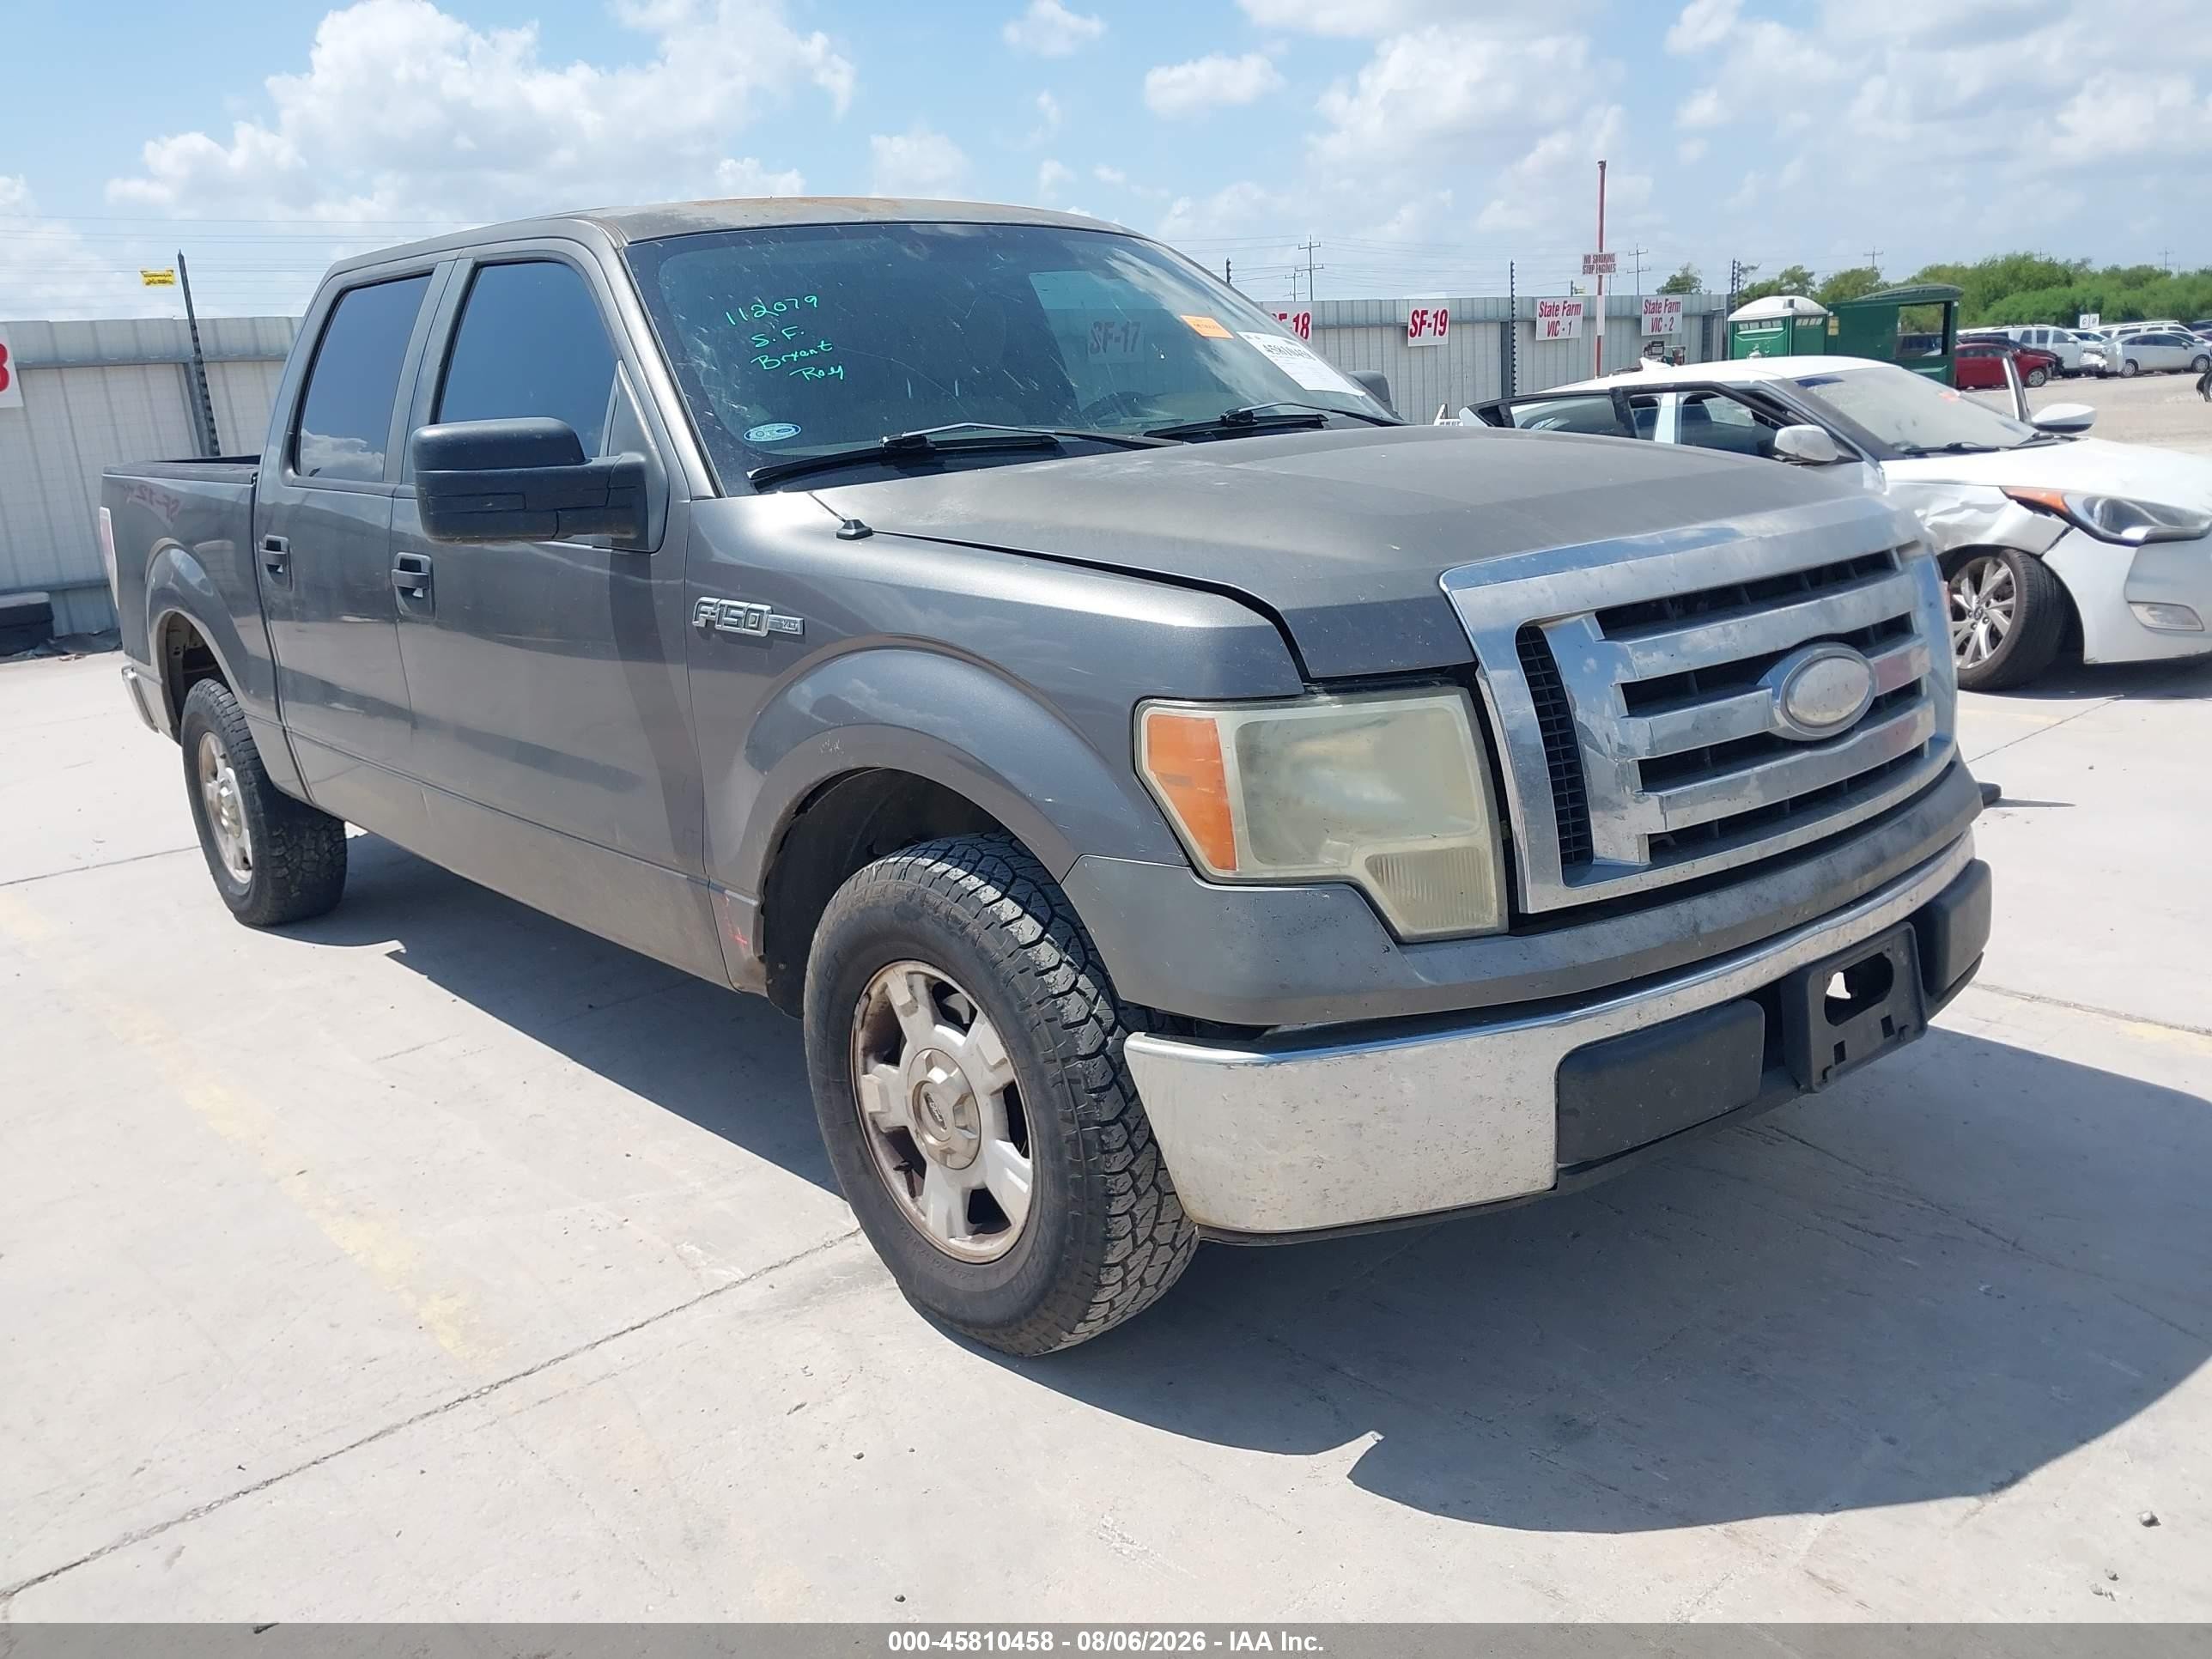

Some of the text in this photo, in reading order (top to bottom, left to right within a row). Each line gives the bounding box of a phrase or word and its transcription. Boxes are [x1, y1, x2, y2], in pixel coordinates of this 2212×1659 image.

[1583, 253, 1615, 264] NO SMOKING
[1583, 264, 1616, 275] STOP ENGINES
[726, 295, 817, 325] 112079
[1539, 301, 1582, 318] State Farm
[1644, 298, 1681, 315] State Farm
[1409, 309, 1449, 338] SF-19
[1547, 319, 1560, 337] VIC
[1568, 319, 1572, 337] 1
[1651, 317, 1662, 333] VIC
[1668, 316, 1674, 331] 2
